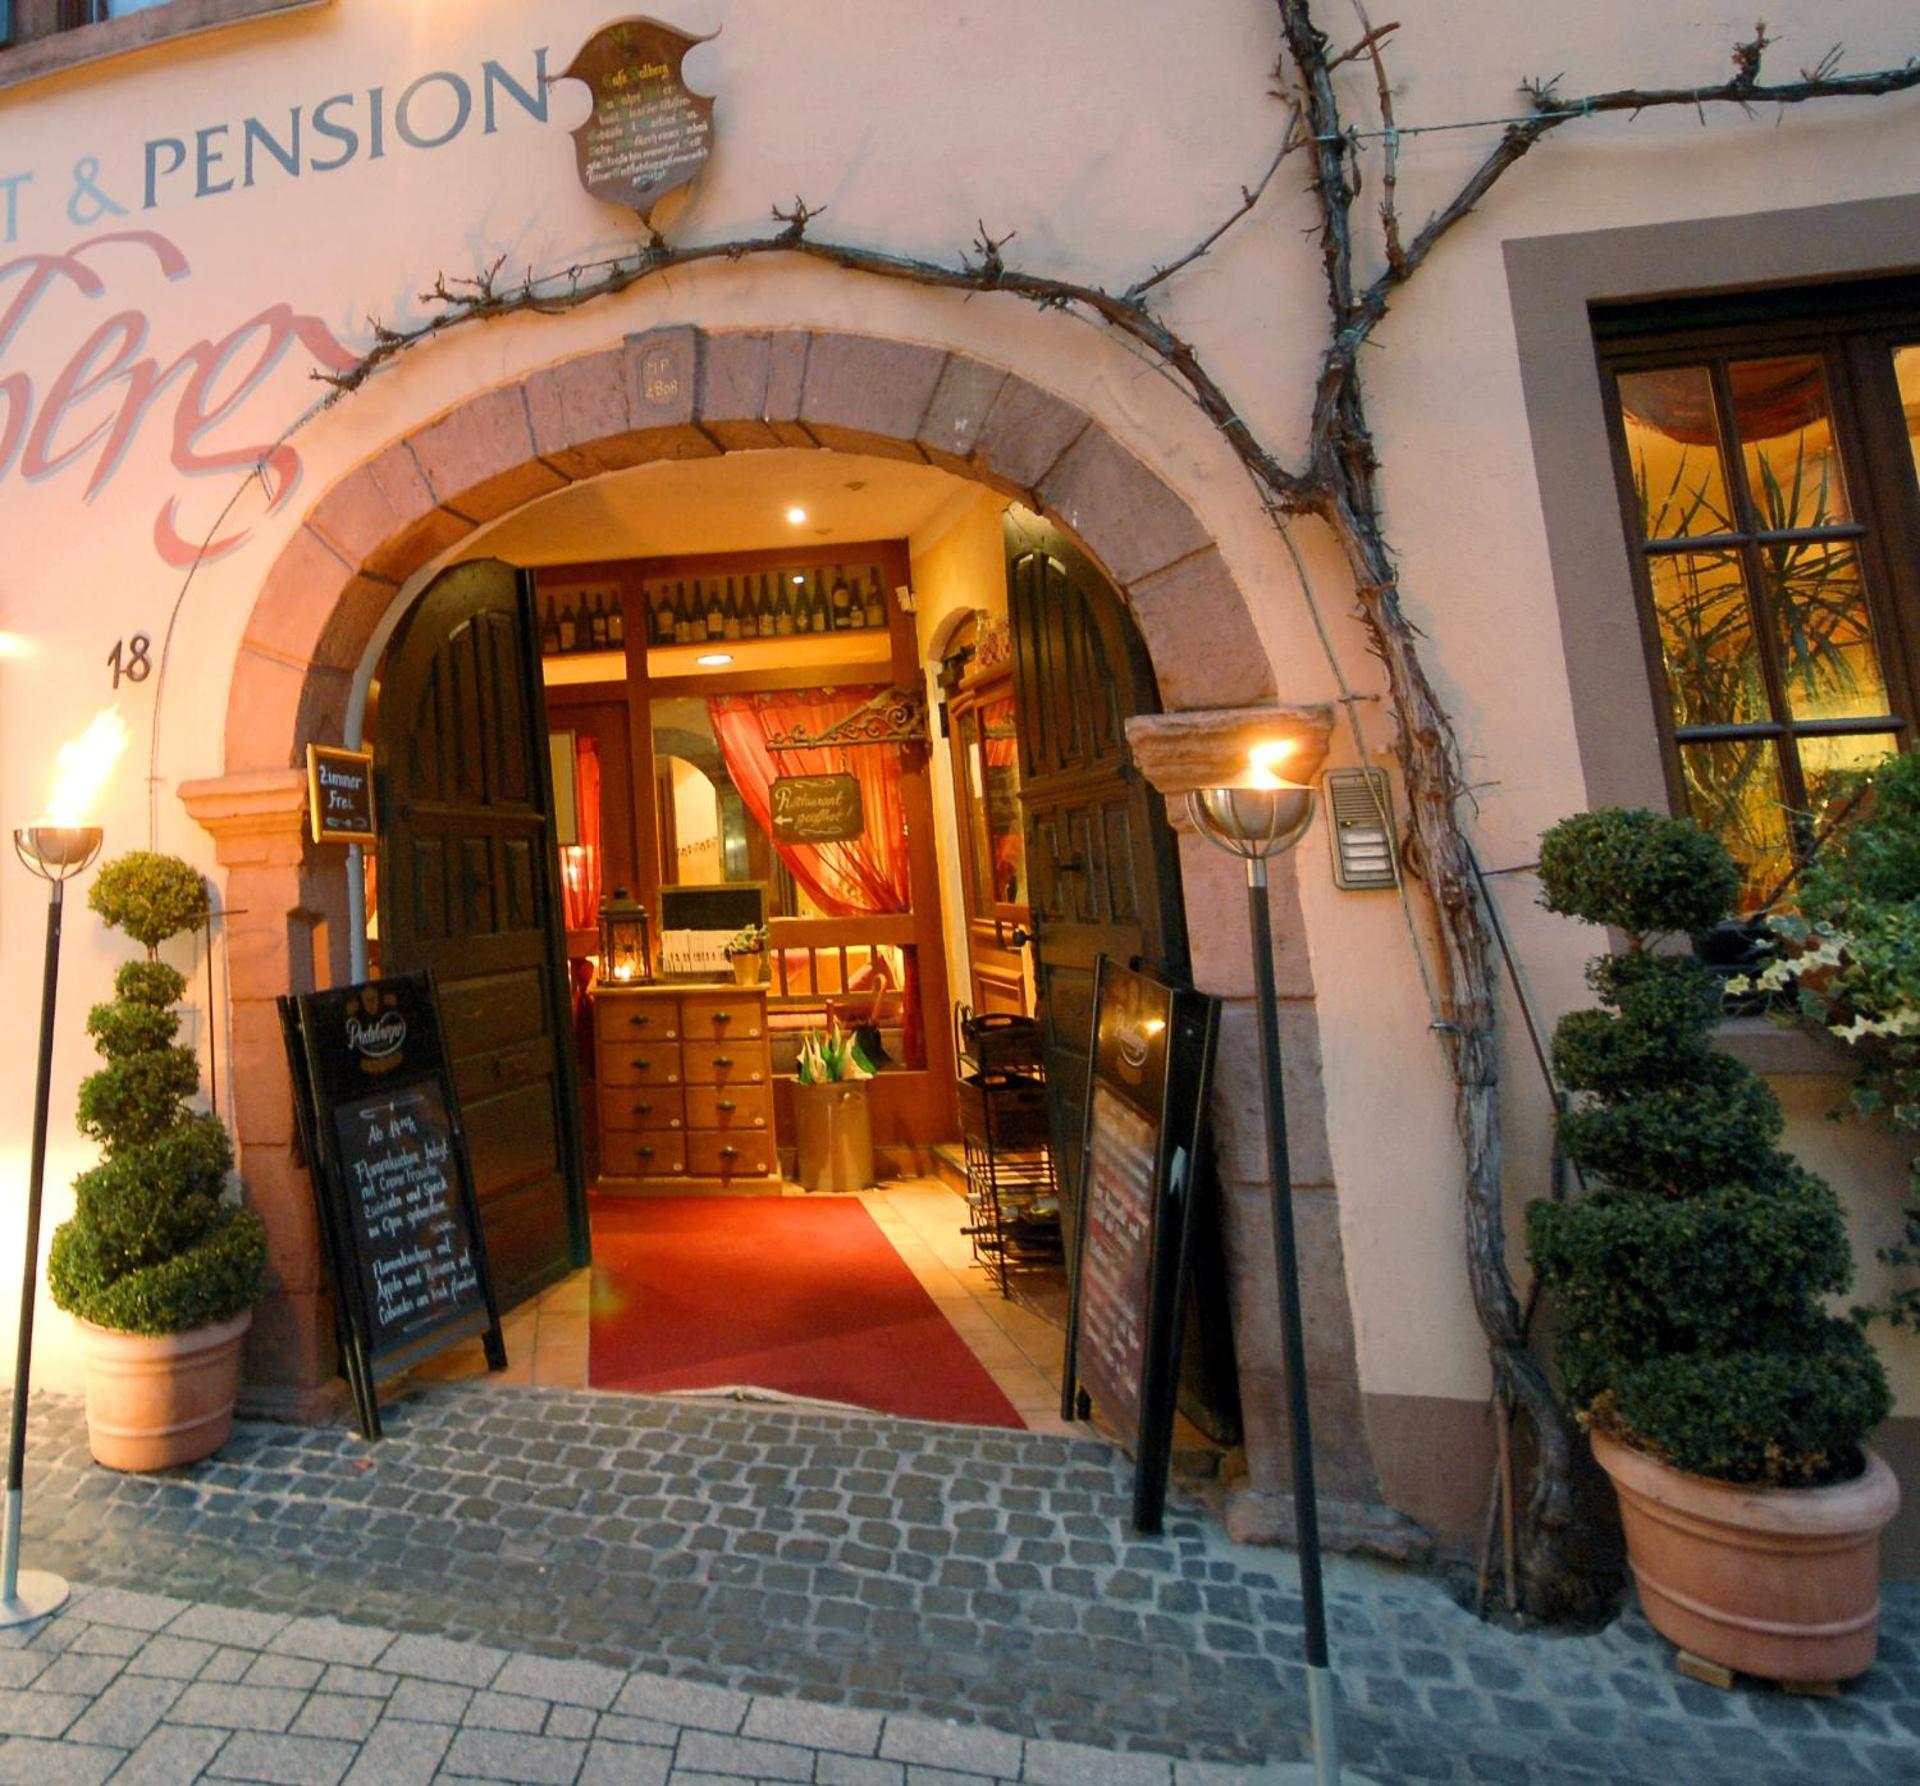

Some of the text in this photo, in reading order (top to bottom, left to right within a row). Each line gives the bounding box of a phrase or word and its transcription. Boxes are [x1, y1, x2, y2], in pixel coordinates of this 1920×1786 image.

[66, 155, 130, 226] &
[142, 46, 549, 210] PENSION
[107, 635, 151, 689] 18
[319, 764, 363, 790] Zimmer
[775, 787, 843, 812] Restaurant
